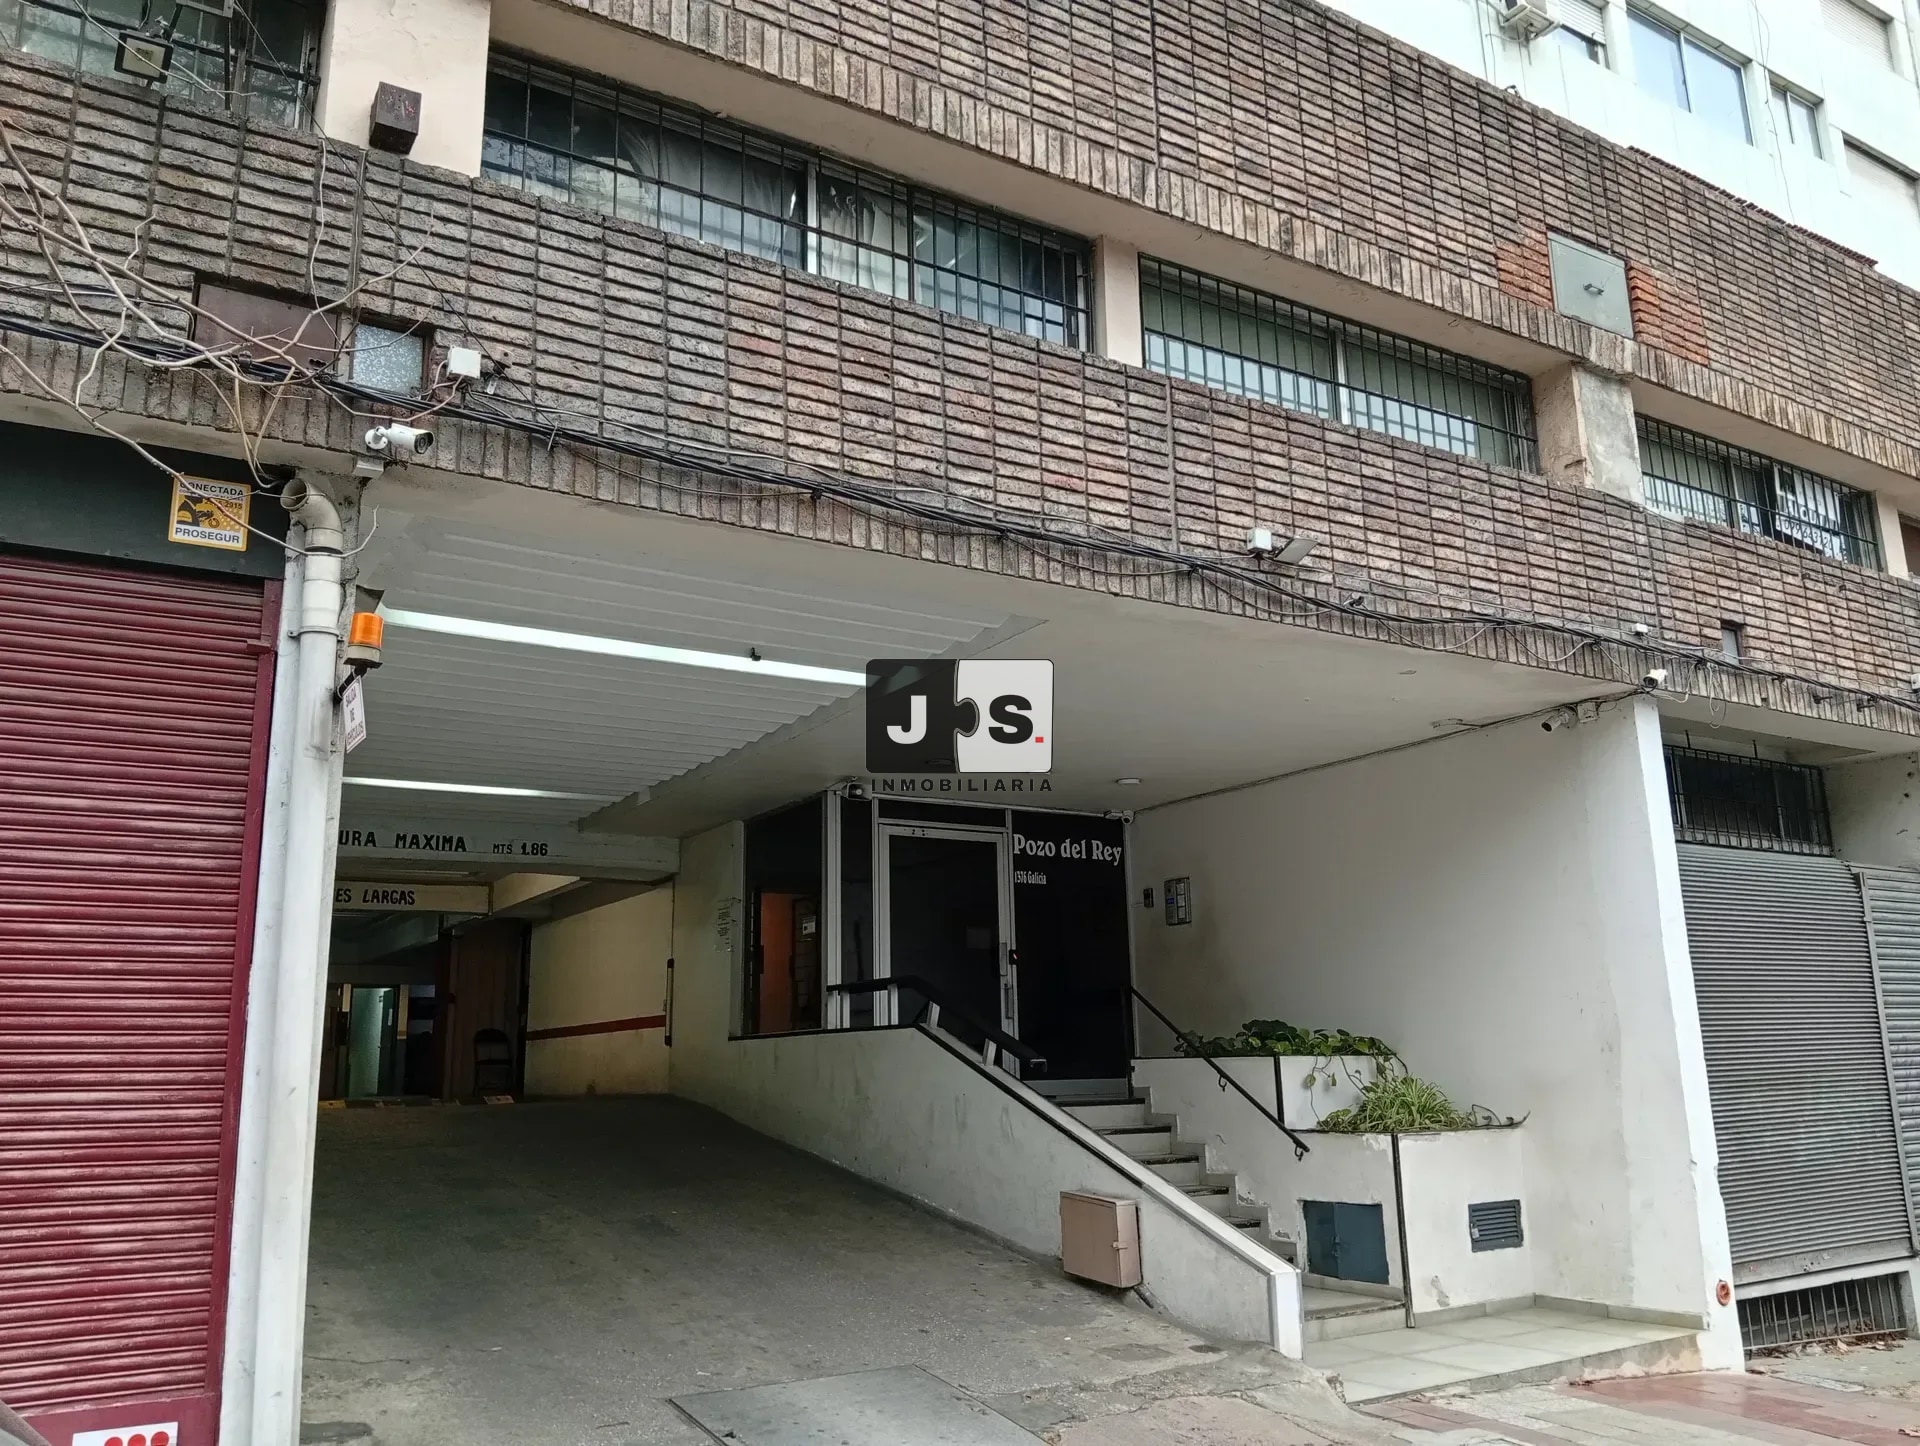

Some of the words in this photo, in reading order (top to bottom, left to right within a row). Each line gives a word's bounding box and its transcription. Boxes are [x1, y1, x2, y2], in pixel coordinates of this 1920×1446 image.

[175, 527, 240, 543] PROSEGUR
[395, 833, 467, 853] MAXIMA
[492, 843, 513, 854] MTS
[1013, 833, 1056, 857] Pozo
[1060, 838, 1087, 859] del
[1091, 840, 1122, 866] Rey
[362, 889, 416, 906] LARGAS
